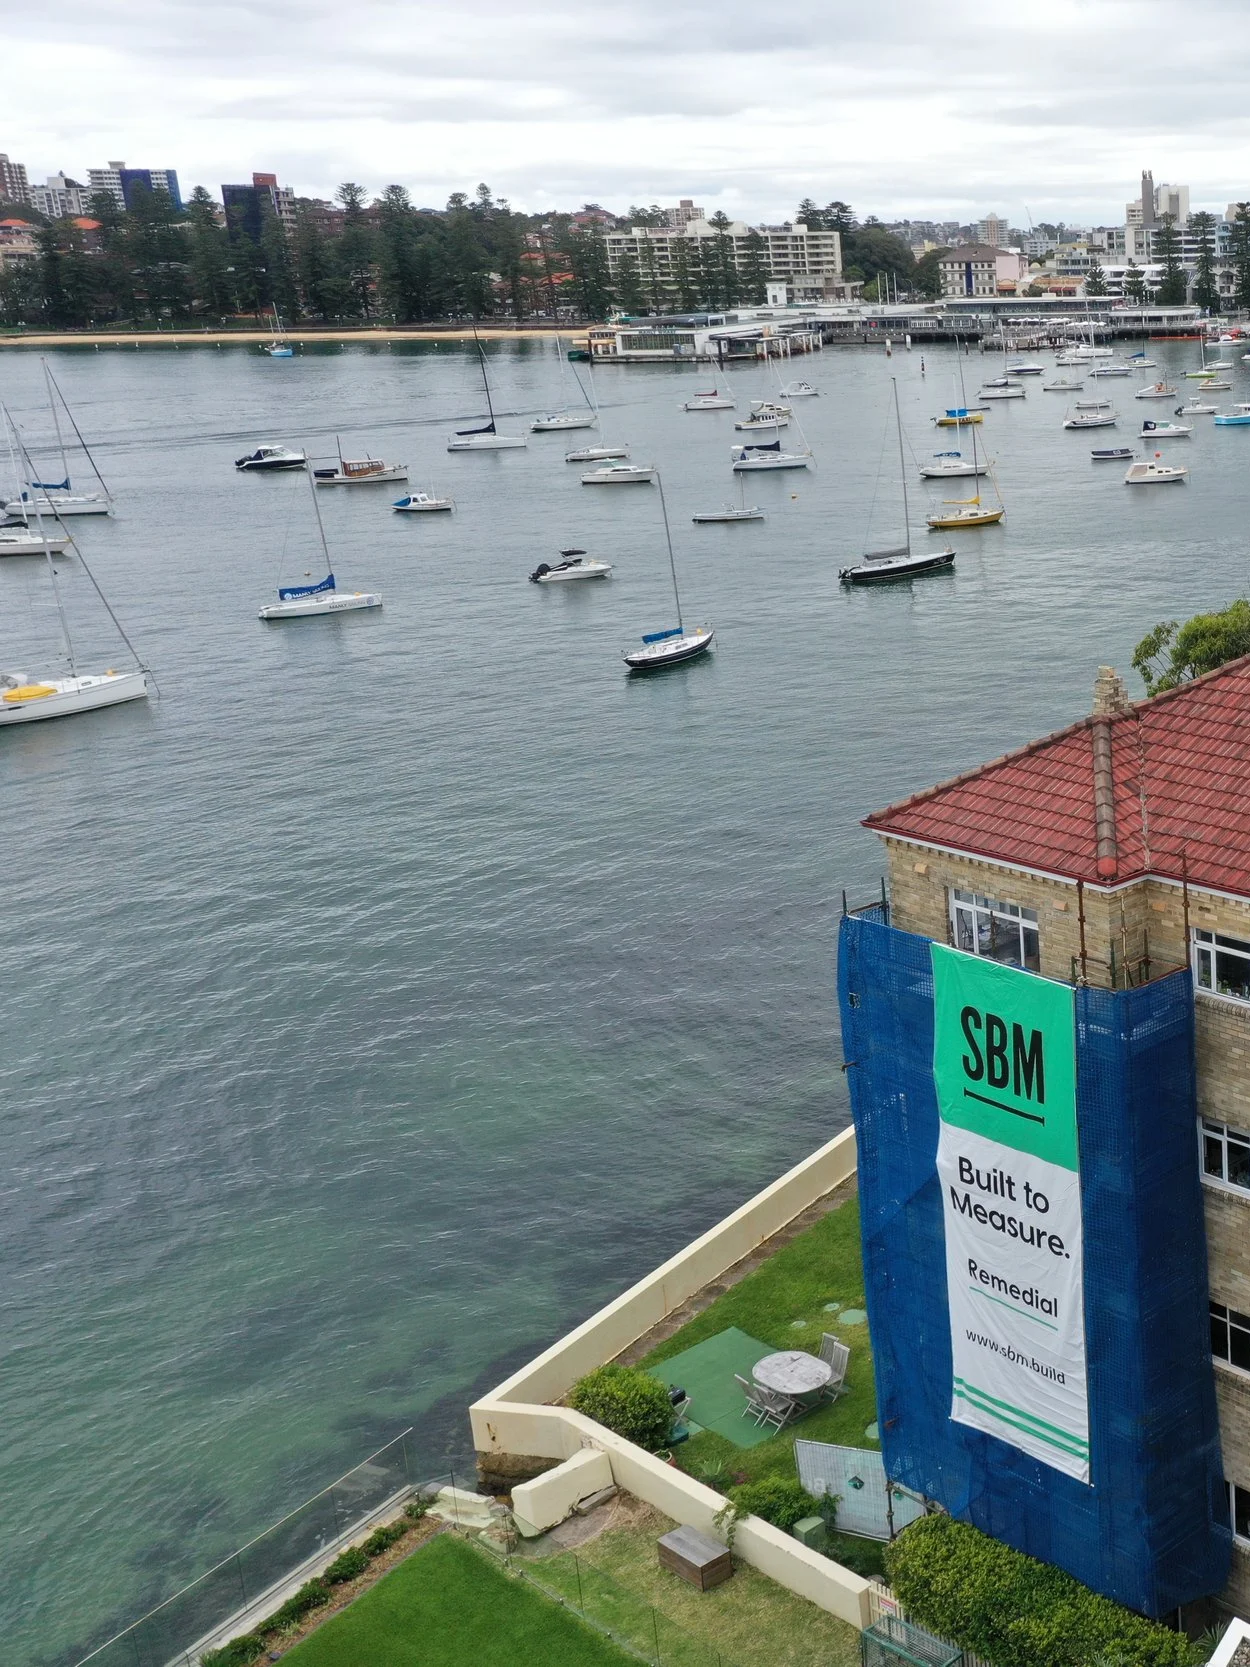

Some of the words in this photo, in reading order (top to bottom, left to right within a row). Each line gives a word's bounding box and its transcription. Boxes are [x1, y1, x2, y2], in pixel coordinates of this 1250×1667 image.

[960, 1005, 1045, 1105] SBM
[958, 1155, 1017, 1202] Built
[1023, 1181, 1050, 1214] to
[950, 1185, 1070, 1259] Measure.
[968, 1258, 1058, 1318] Remedial
[966, 1329, 1066, 1385] www.sbm.build
